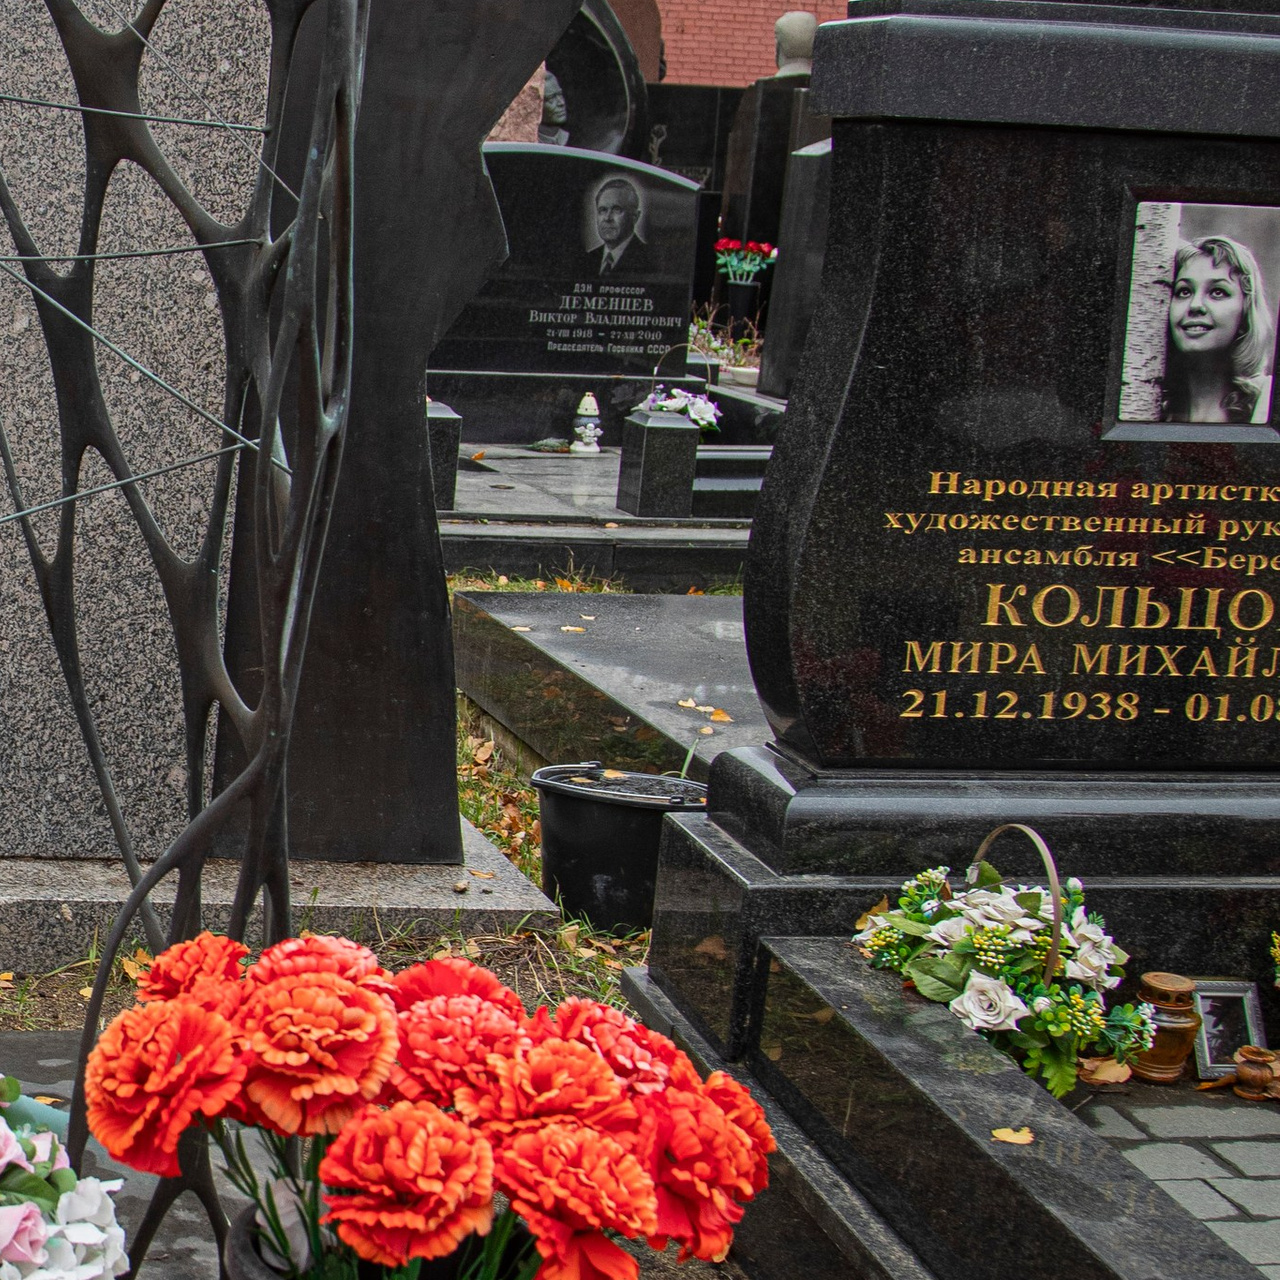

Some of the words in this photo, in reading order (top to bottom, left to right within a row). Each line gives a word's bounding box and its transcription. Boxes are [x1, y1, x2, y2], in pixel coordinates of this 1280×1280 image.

[559, 295, 654, 312] ДЕМЕНЦЕВ
[572, 329, 593, 339] 1918
[638, 331, 663, 341] 2010
[647, 344, 671, 355] СССР
[927, 470, 1118, 501] Народная
[1131, 484, 1280, 504] артистк
[883, 511, 1207, 534] художественный
[1217, 519, 1280, 541] рук
[957, 546, 1139, 567] ансамбля
[902, 641, 1046, 675] МИРА
[899, 688, 1140, 721] 21.12.1938
